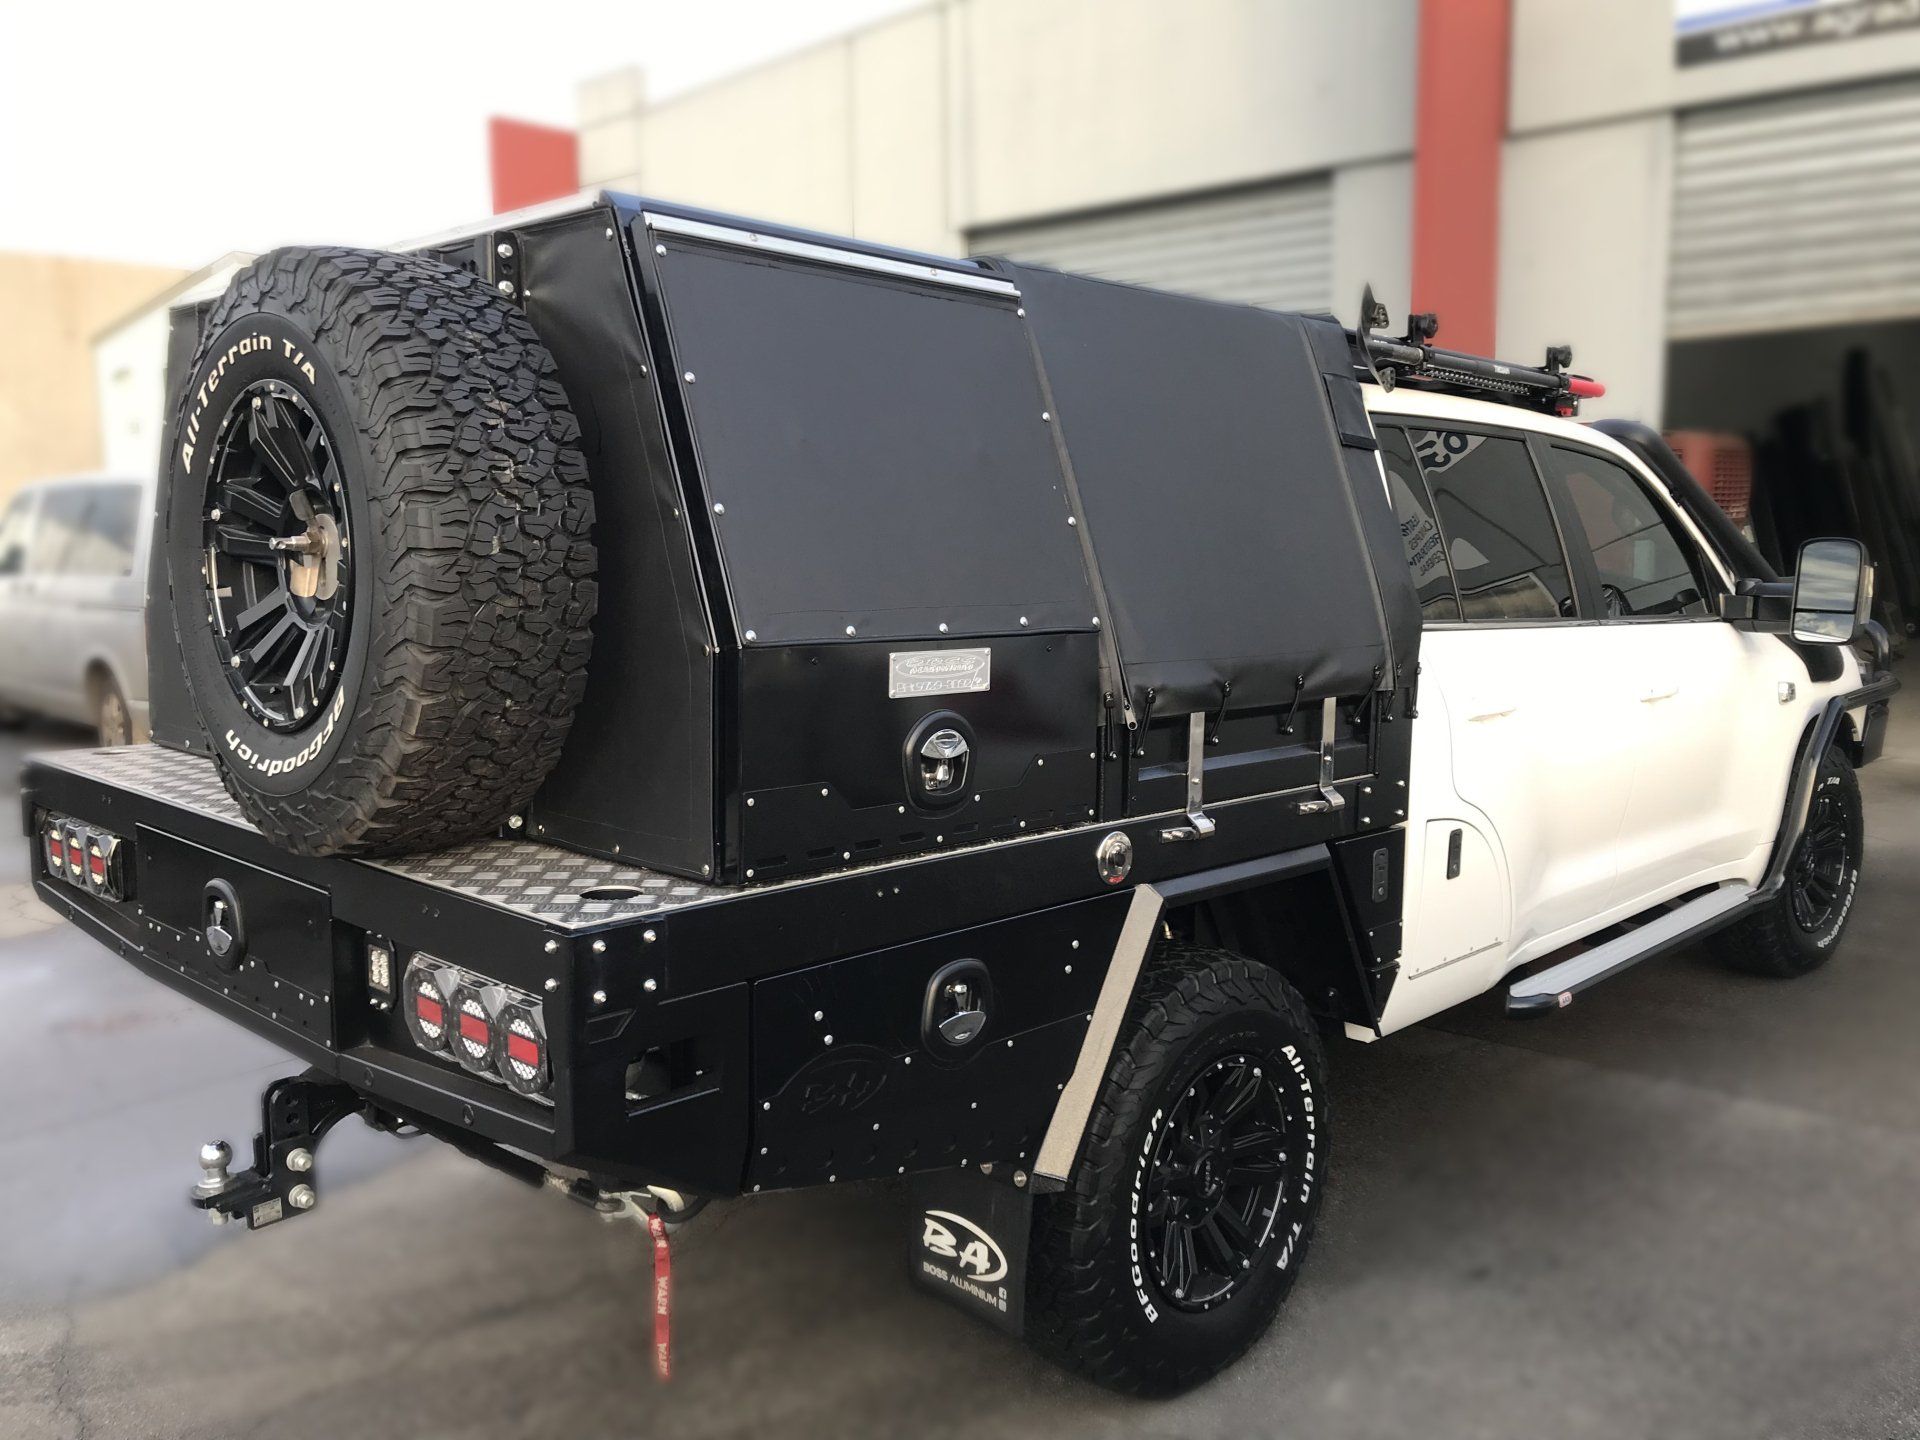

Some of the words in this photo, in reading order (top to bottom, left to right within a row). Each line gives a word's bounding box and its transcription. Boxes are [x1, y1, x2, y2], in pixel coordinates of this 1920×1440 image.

[182, 332, 272, 475] All-Terrain
[282, 338, 316, 385] T/A
[225, 685, 345, 777] BFGoodrich
[1280, 1045, 1316, 1204] All-Terrain
[1130, 1108, 1163, 1324] BFGoodrich
[1276, 1222, 1303, 1271] T/A
[923, 1261, 948, 1281] BOSS
[950, 1274, 997, 1308] ALUMINIUM
